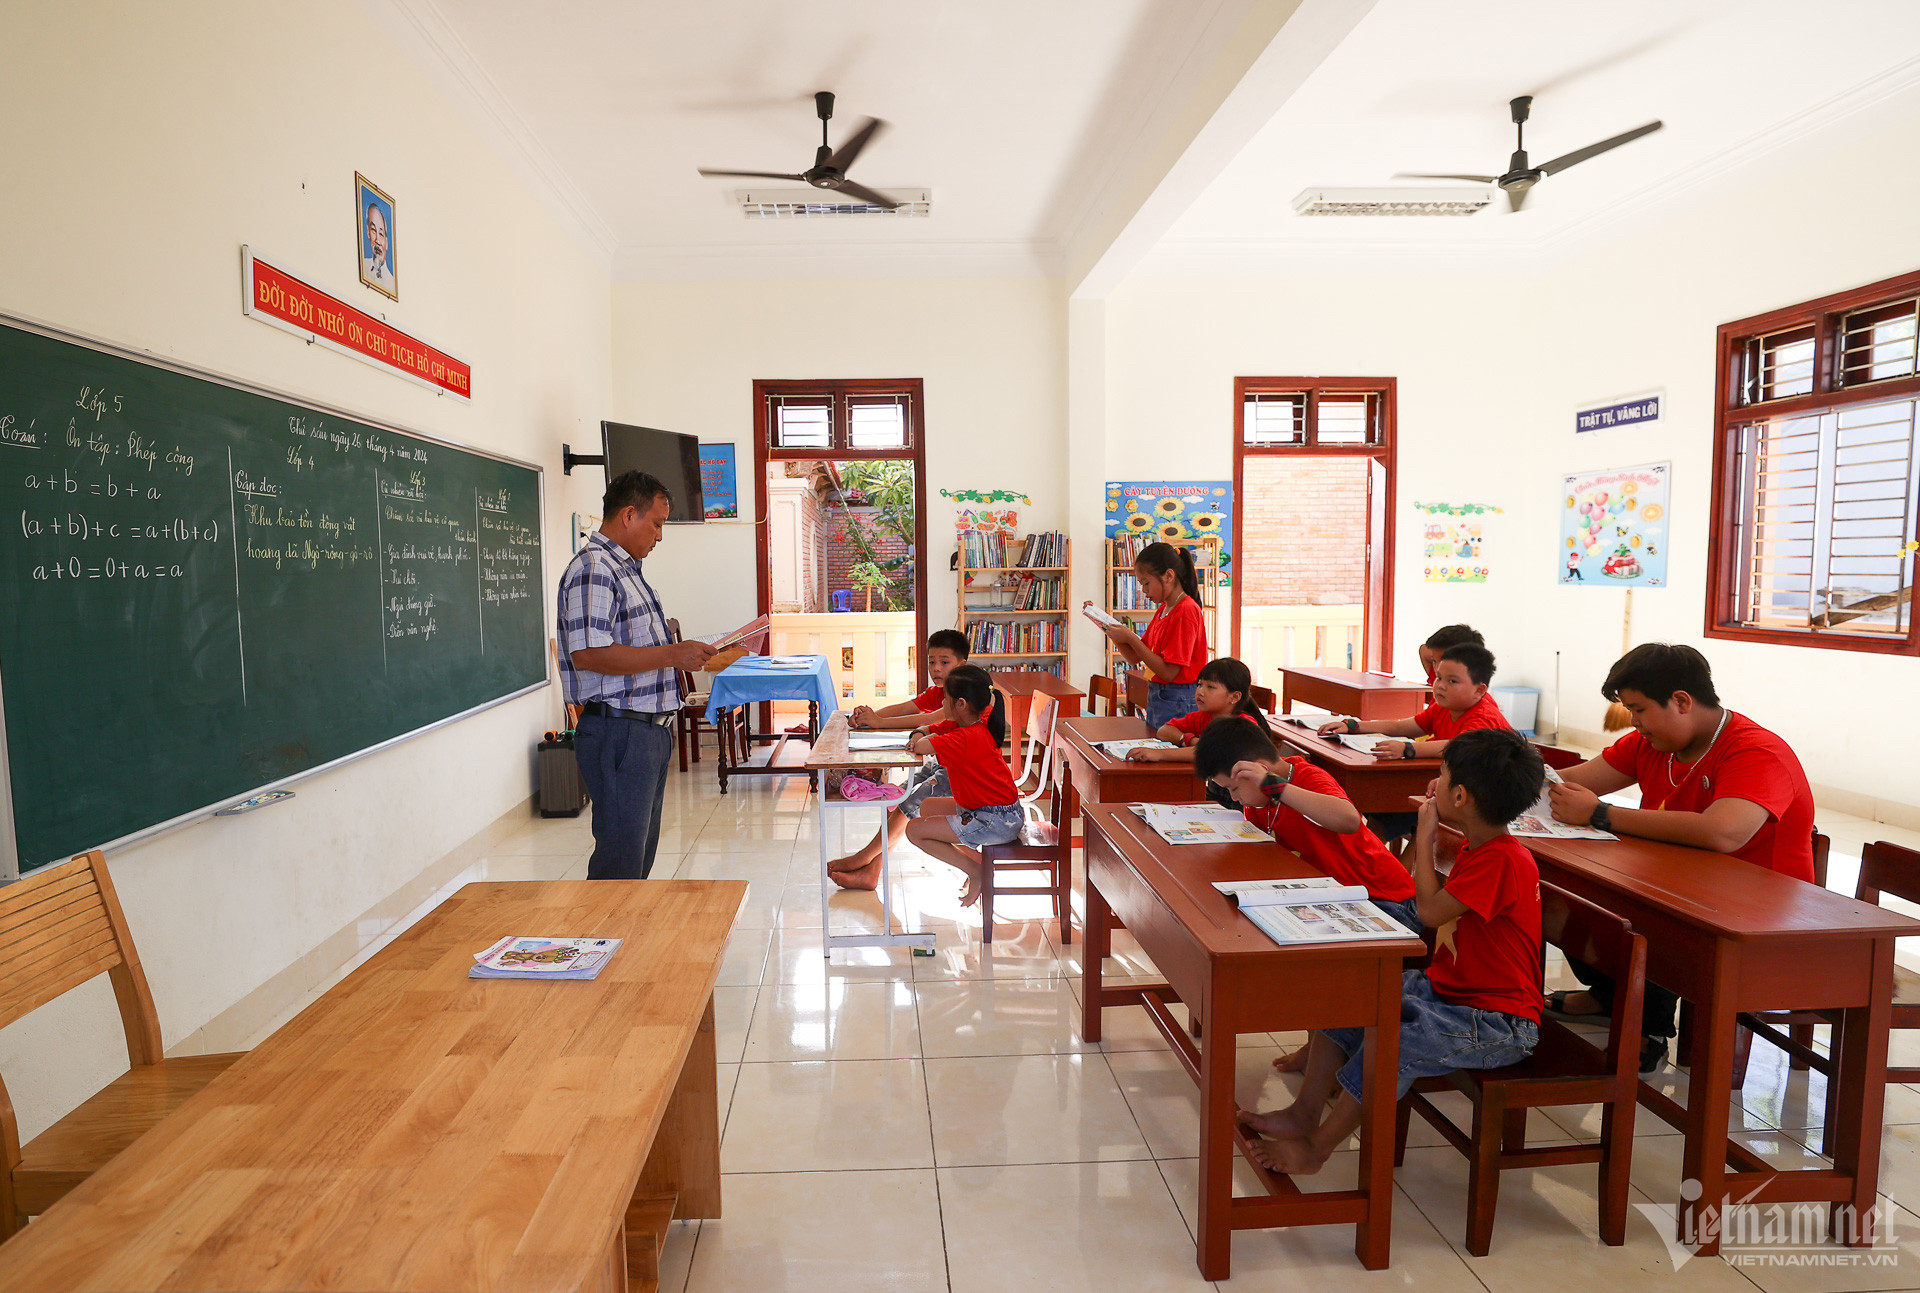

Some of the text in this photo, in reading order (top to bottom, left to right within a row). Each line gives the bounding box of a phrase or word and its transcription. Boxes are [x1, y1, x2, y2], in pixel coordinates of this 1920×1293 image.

[259, 280, 467, 391] ĐỜI ĐỜI NHỚ ƠN CHỦ TỊCH HỒ CHÍ MINH
[114, 395, 124, 413] 5
[1579, 412, 1601, 428] TRẬT
[1642, 401, 1657, 417] LỜI
[165, 445, 195, 476] cộng
[308, 456, 315, 470] 4
[330, 431, 350, 452] ngày
[366, 435, 388, 462] tháng
[389, 445, 395, 456] 4
[397, 446, 411, 460] năm
[413, 448, 428, 464] 2024
[24, 474, 41, 489] a
[65, 468, 78, 493] b
[107, 474, 118, 497] b
[147, 487, 162, 500] a
[1145, 485, 1175, 496] TUYÊN
[1177, 485, 1209, 496] DƯƠNG
[244, 503, 273, 526] Khu
[298, 508, 313, 528] tồn
[319, 513, 340, 539] động
[245, 537, 281, 570] hoang
[285, 542, 298, 558] dã
